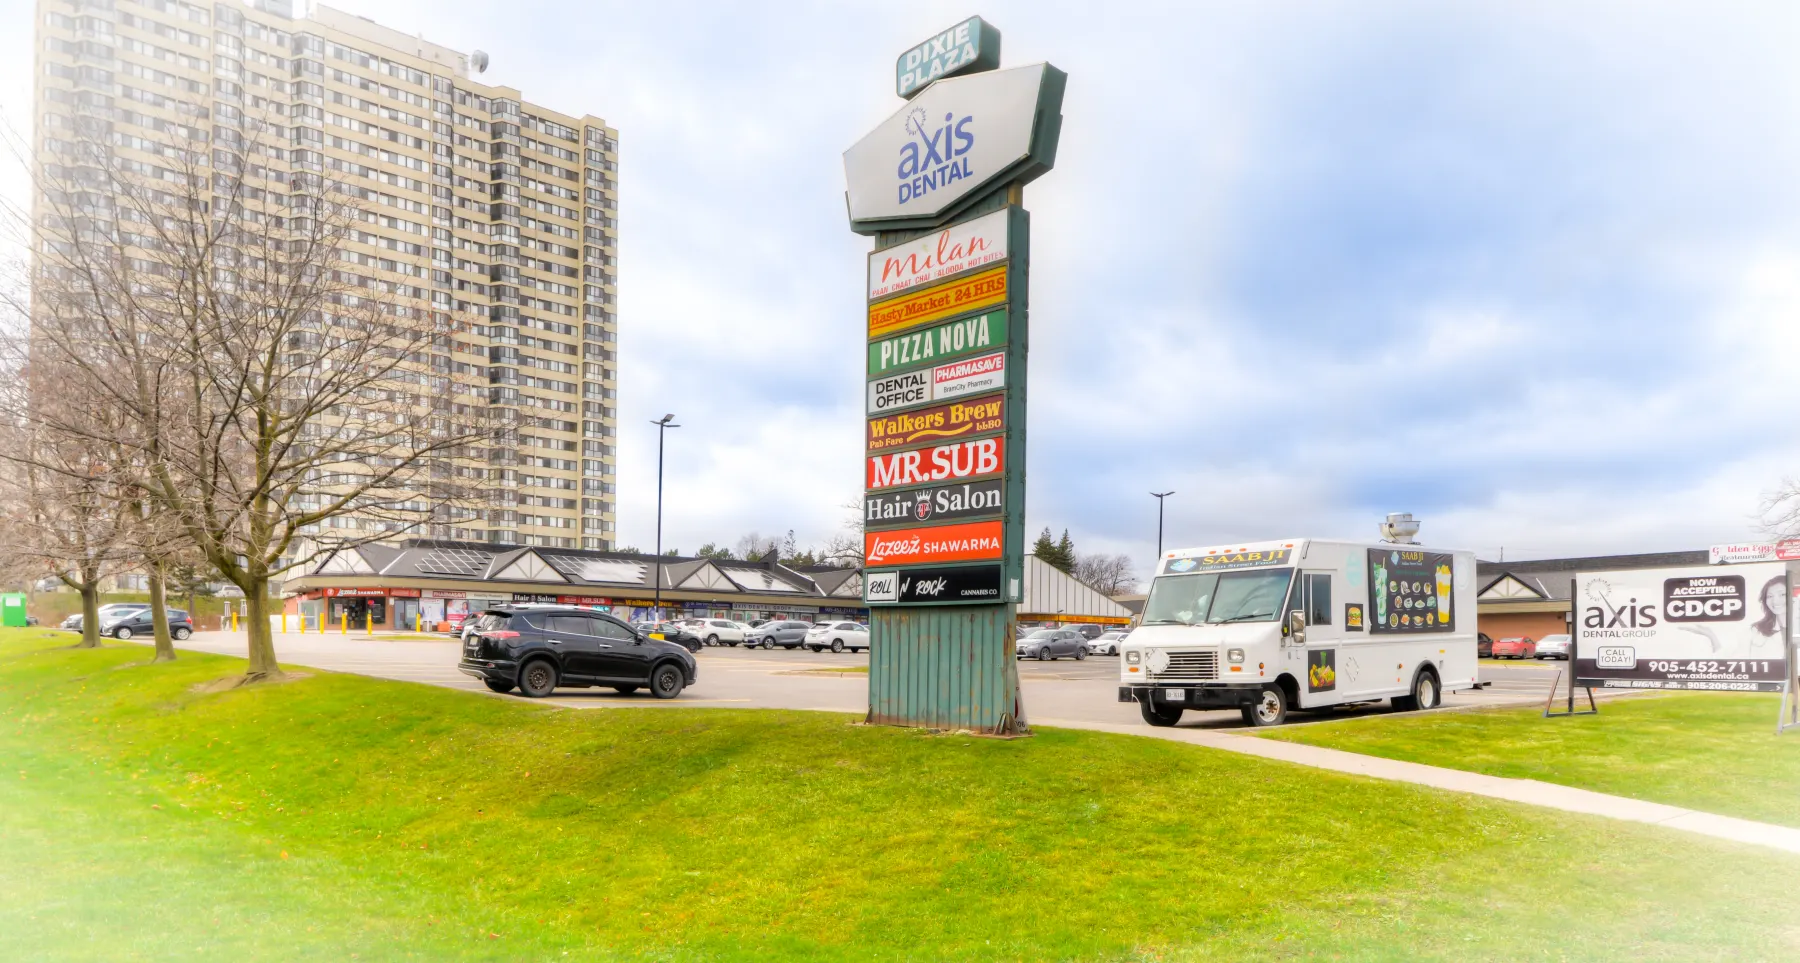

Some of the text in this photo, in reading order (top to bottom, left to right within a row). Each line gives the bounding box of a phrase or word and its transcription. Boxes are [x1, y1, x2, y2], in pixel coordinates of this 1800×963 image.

[906, 21, 970, 71] DIXIE
[900, 41, 977, 94] PLAZA
[898, 112, 974, 180] axis
[899, 157, 973, 204] DENTAL
[872, 251, 1004, 297] PAAN CHAAT CHAI ALOODA HOT BITES
[881, 315, 990, 370] PIZZA NOVA
[936, 356, 1003, 381] PHARMASAVE
[876, 373, 927, 394] DENTAL
[967, 378, 993, 389] Pharmacy
[876, 388, 924, 408] OFFICE
[869, 401, 1002, 439] Walkers Brew
[869, 437, 904, 449] Pub Fare
[867, 495, 912, 521] Hair
[935, 485, 1002, 514] Salon
[867, 535, 1000, 561] Lazeez SHAWARMA
[1202, 552, 1262, 565] SAAB
[1401, 551, 1418, 560] SAAB
[1712, 546, 1749, 556] Glden
[869, 578, 892, 595] ROLL
[900, 577, 911, 597] N
[915, 576, 947, 597] ROCK
[960, 588, 988, 596] CANNABIS
[1673, 586, 1736, 596] ACCEPTING
[1689, 578, 1717, 587] NOW
[1584, 591, 1657, 629] axis
[1666, 599, 1743, 618] CDCP
[1601, 656, 1631, 664] TODAY!
[1649, 661, 1769, 673] 905-452-7111
